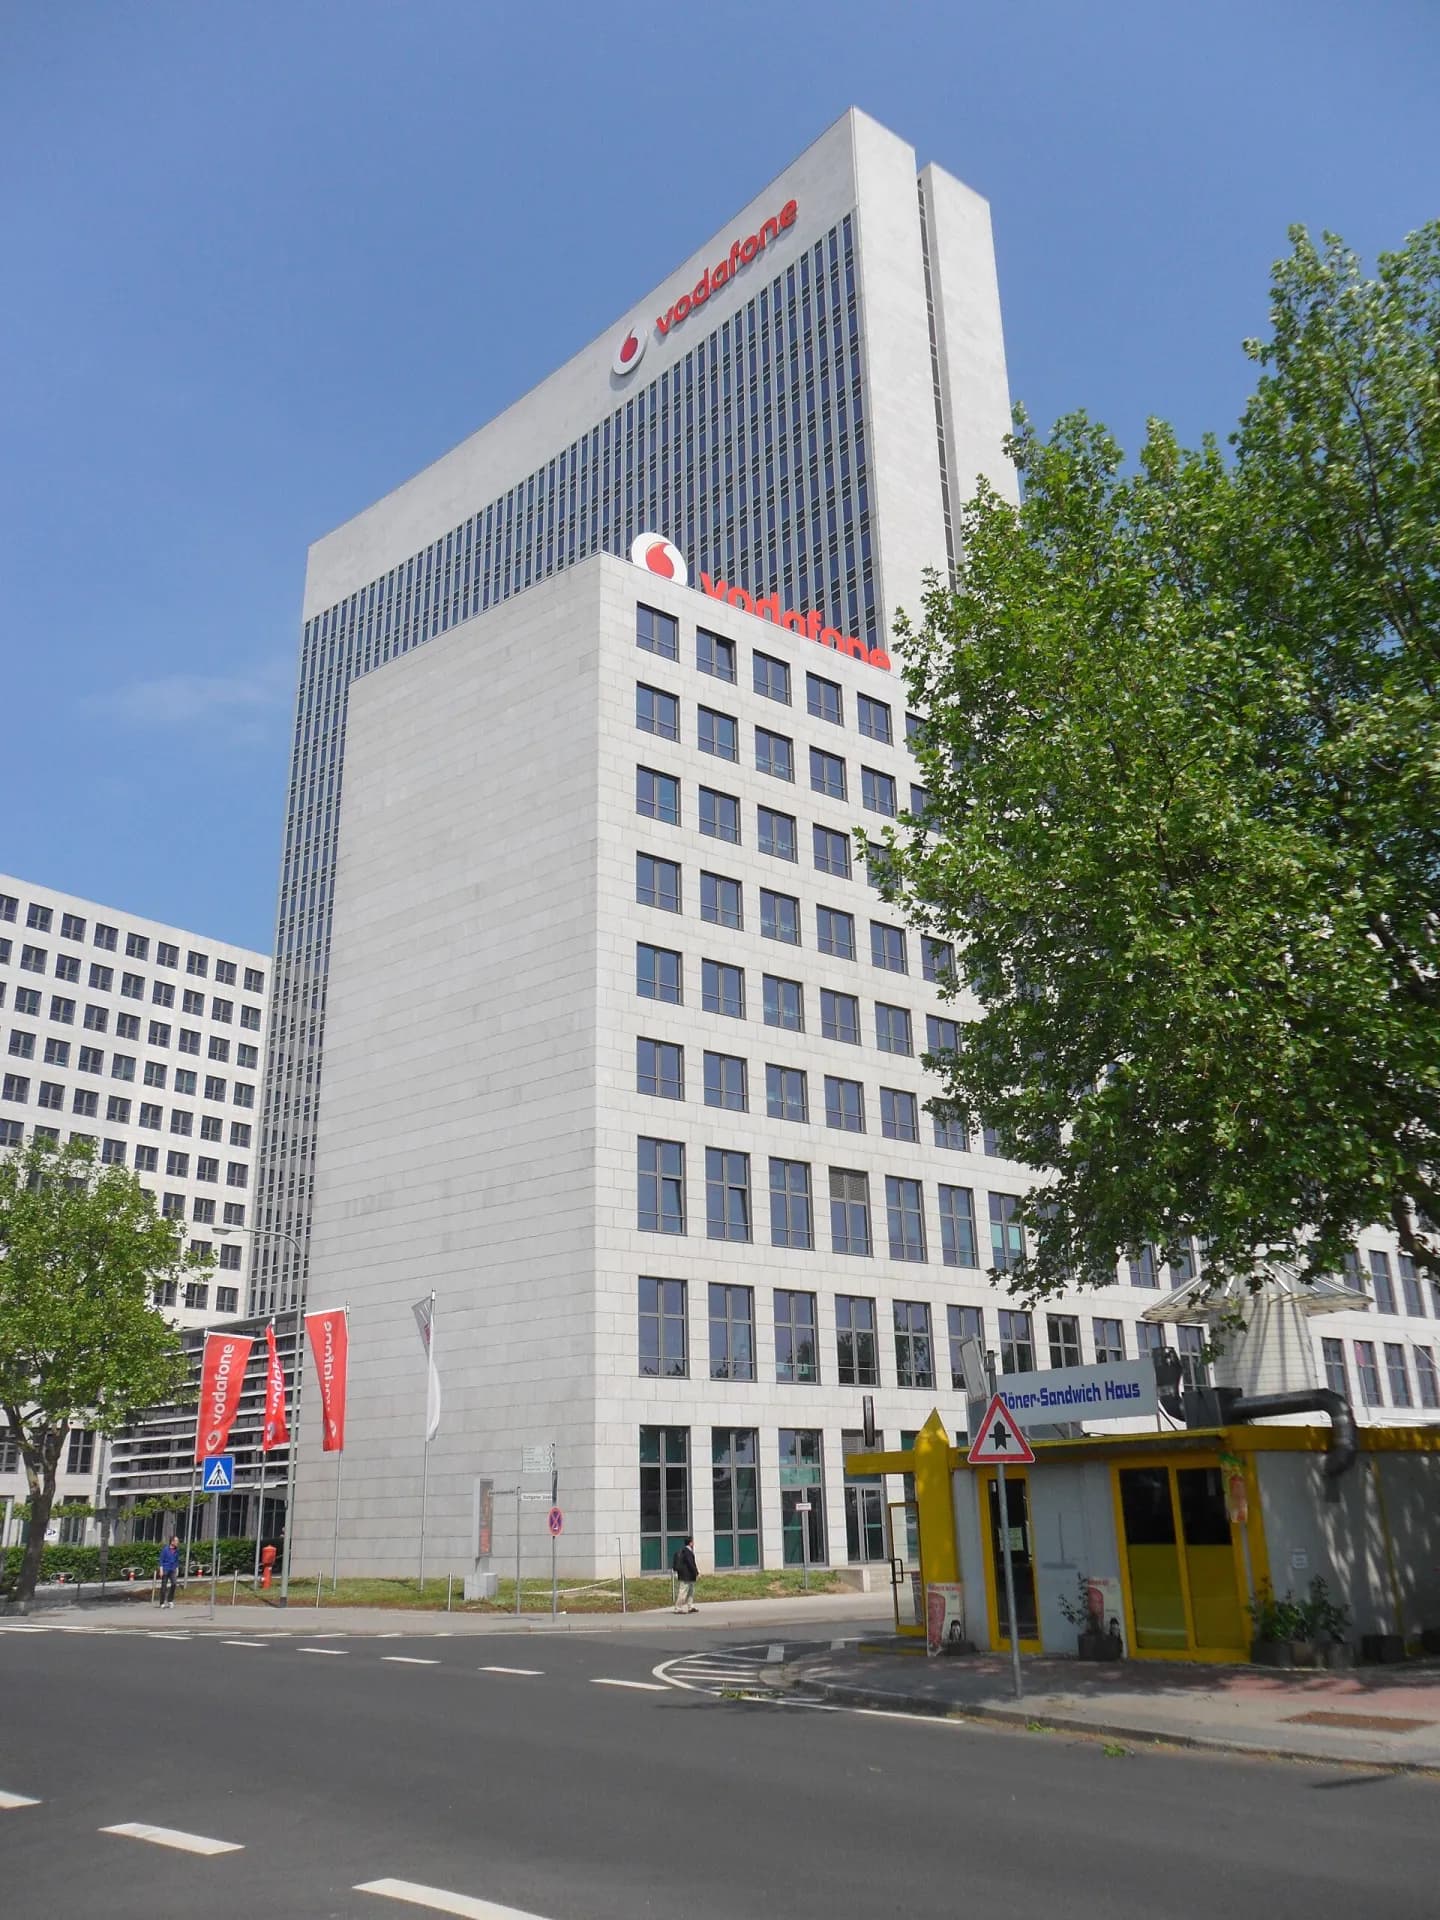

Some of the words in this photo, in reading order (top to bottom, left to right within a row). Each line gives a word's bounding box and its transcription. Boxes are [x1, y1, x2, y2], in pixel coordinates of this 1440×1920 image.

[656, 199, 798, 336] vodafone
[700, 571, 891, 672] vodafone
[211, 1343, 234, 1425] vodafone
[1104, 1380, 1141, 1401] Haus
